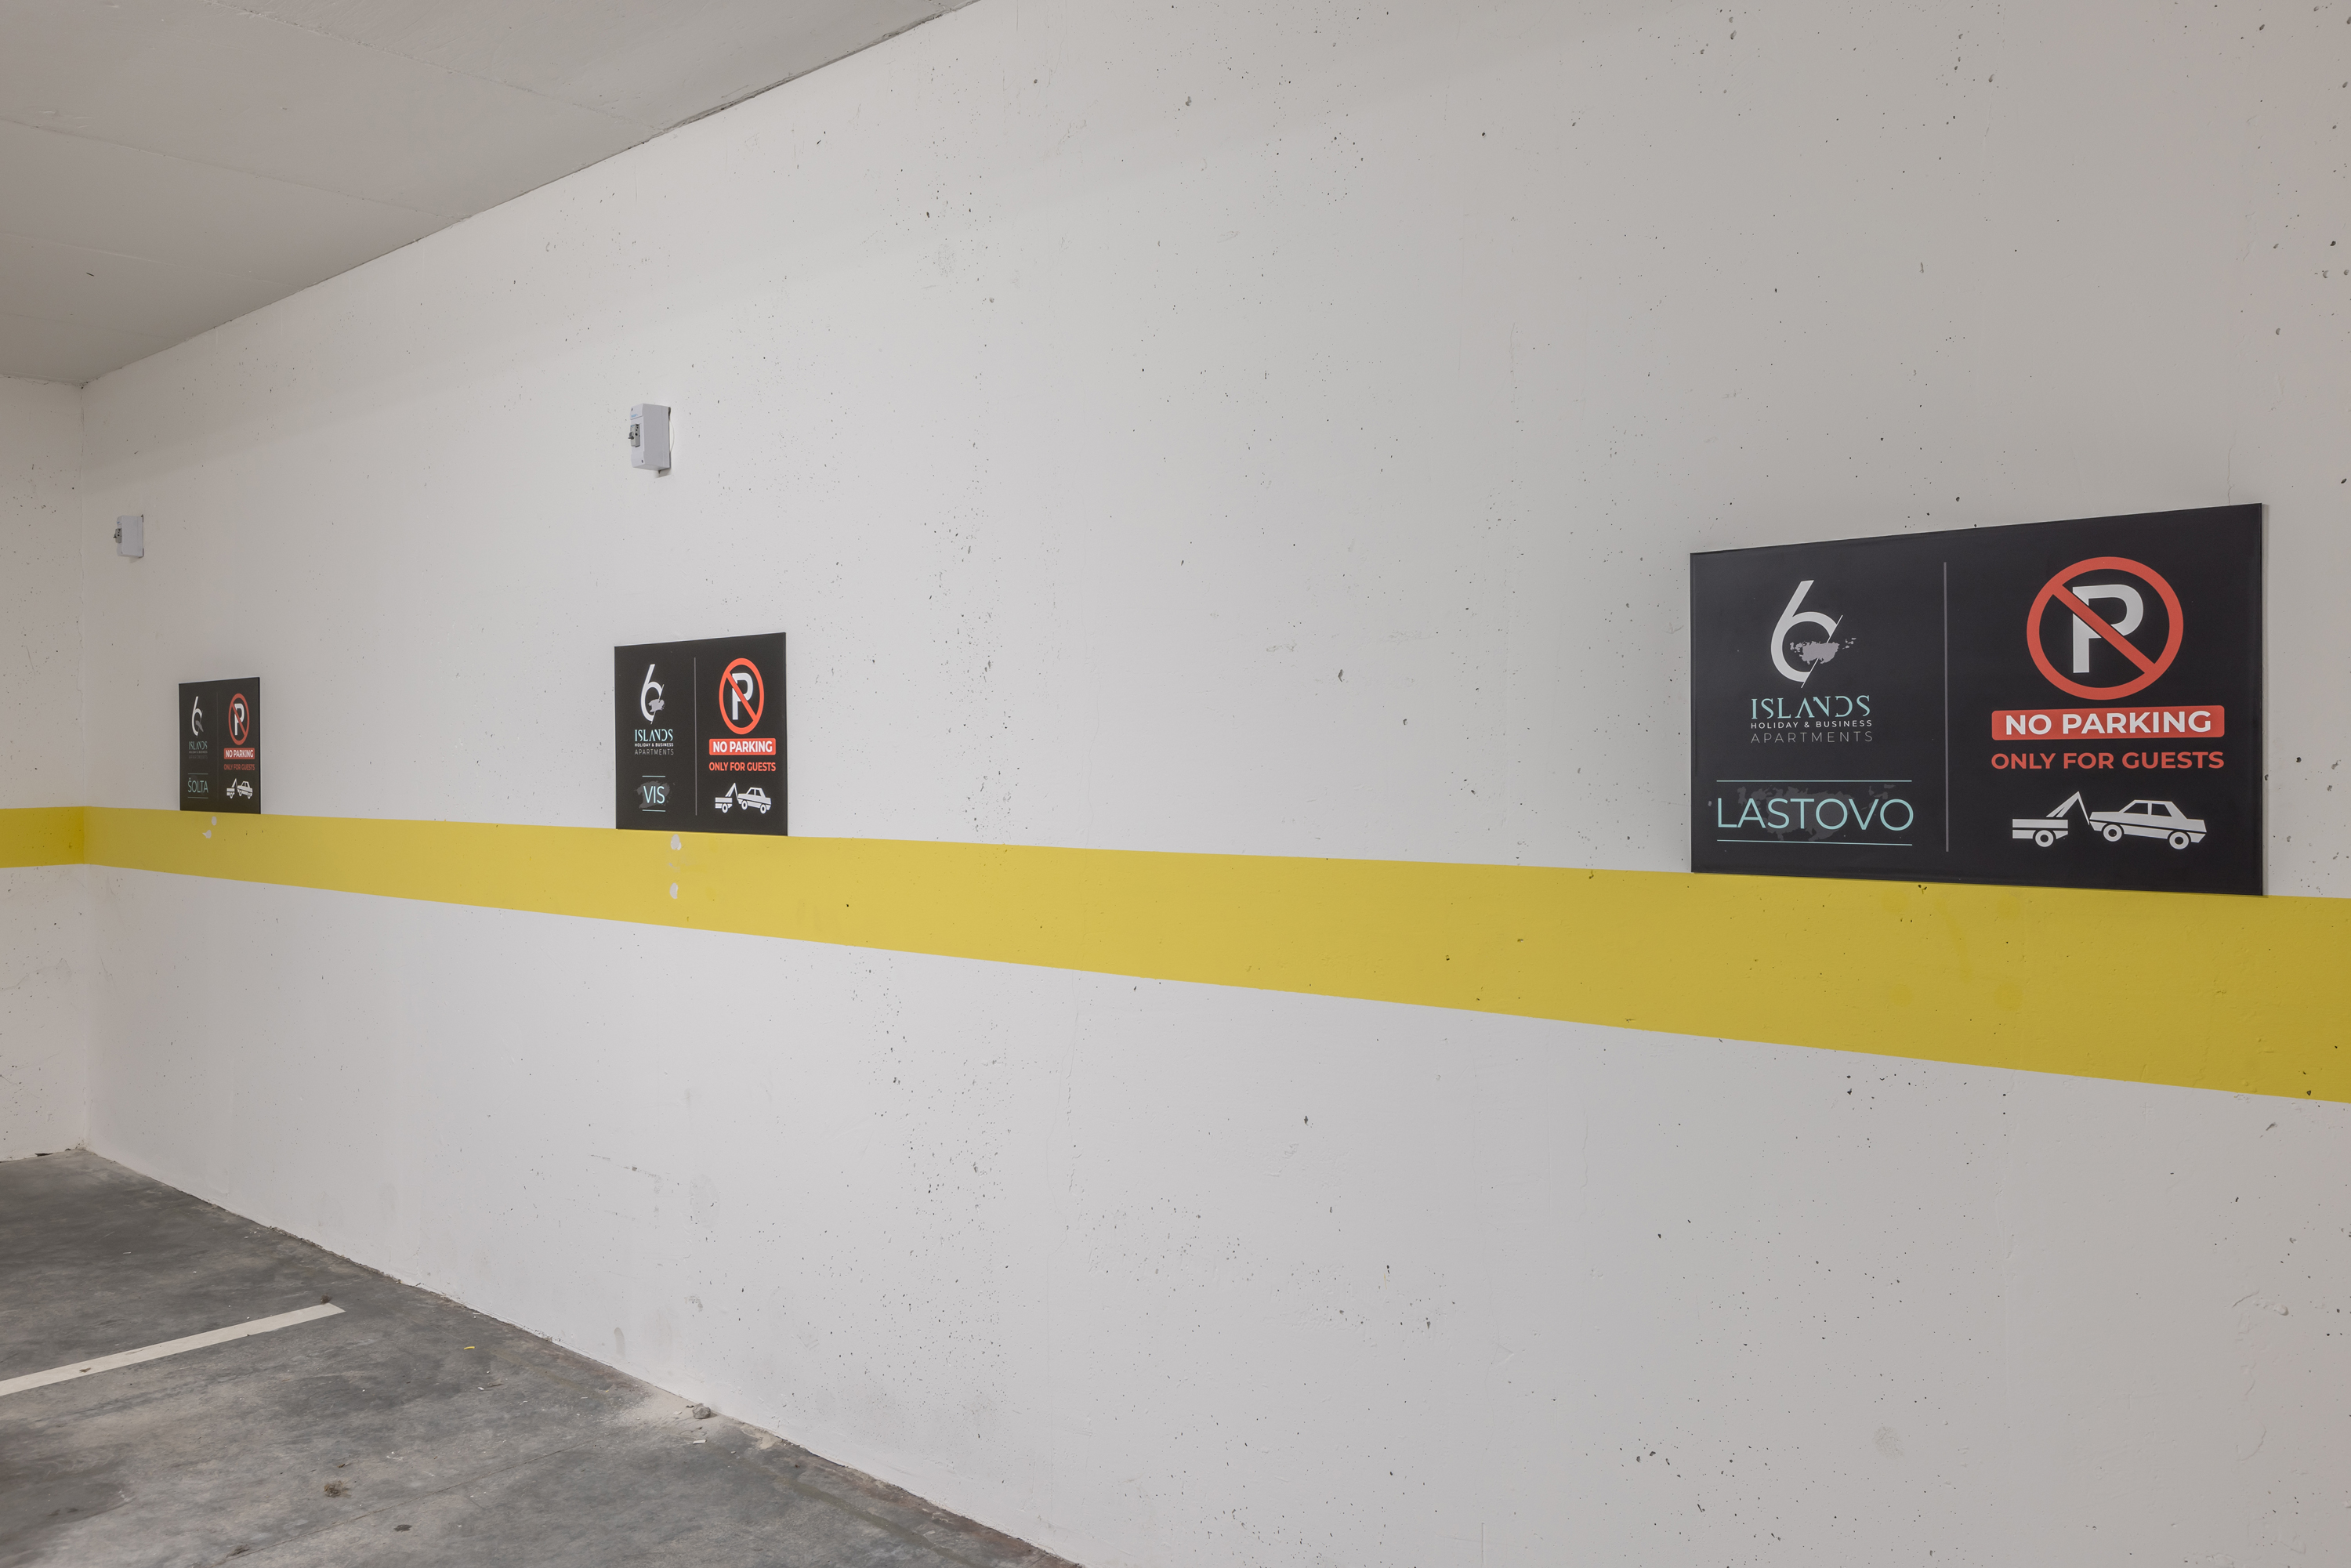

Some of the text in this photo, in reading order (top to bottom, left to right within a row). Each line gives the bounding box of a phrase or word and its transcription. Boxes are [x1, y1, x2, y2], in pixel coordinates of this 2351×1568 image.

[1770, 580, 1843, 688] 6
[2071, 584, 2144, 673] P
[640, 664, 665, 724] 6
[731, 672, 754, 720] P
[1751, 695, 1871, 719] ISLANDS
[1816, 719, 1872, 728] BUSINESS
[2005, 710, 2212, 735] NO PARKING
[635, 729, 673, 741] ISLANDS
[1751, 730, 1873, 744] APARTMENTS
[712, 741, 773, 753] NO PARKING
[709, 762, 776, 771] ONLY FOR GUESTS
[1991, 751, 2224, 770] ONLY FOR GUESTS
[187, 777, 208, 793] ŠOLTA
[643, 786, 665, 804] VIS
[1716, 798, 1914, 831] LASTOVO
